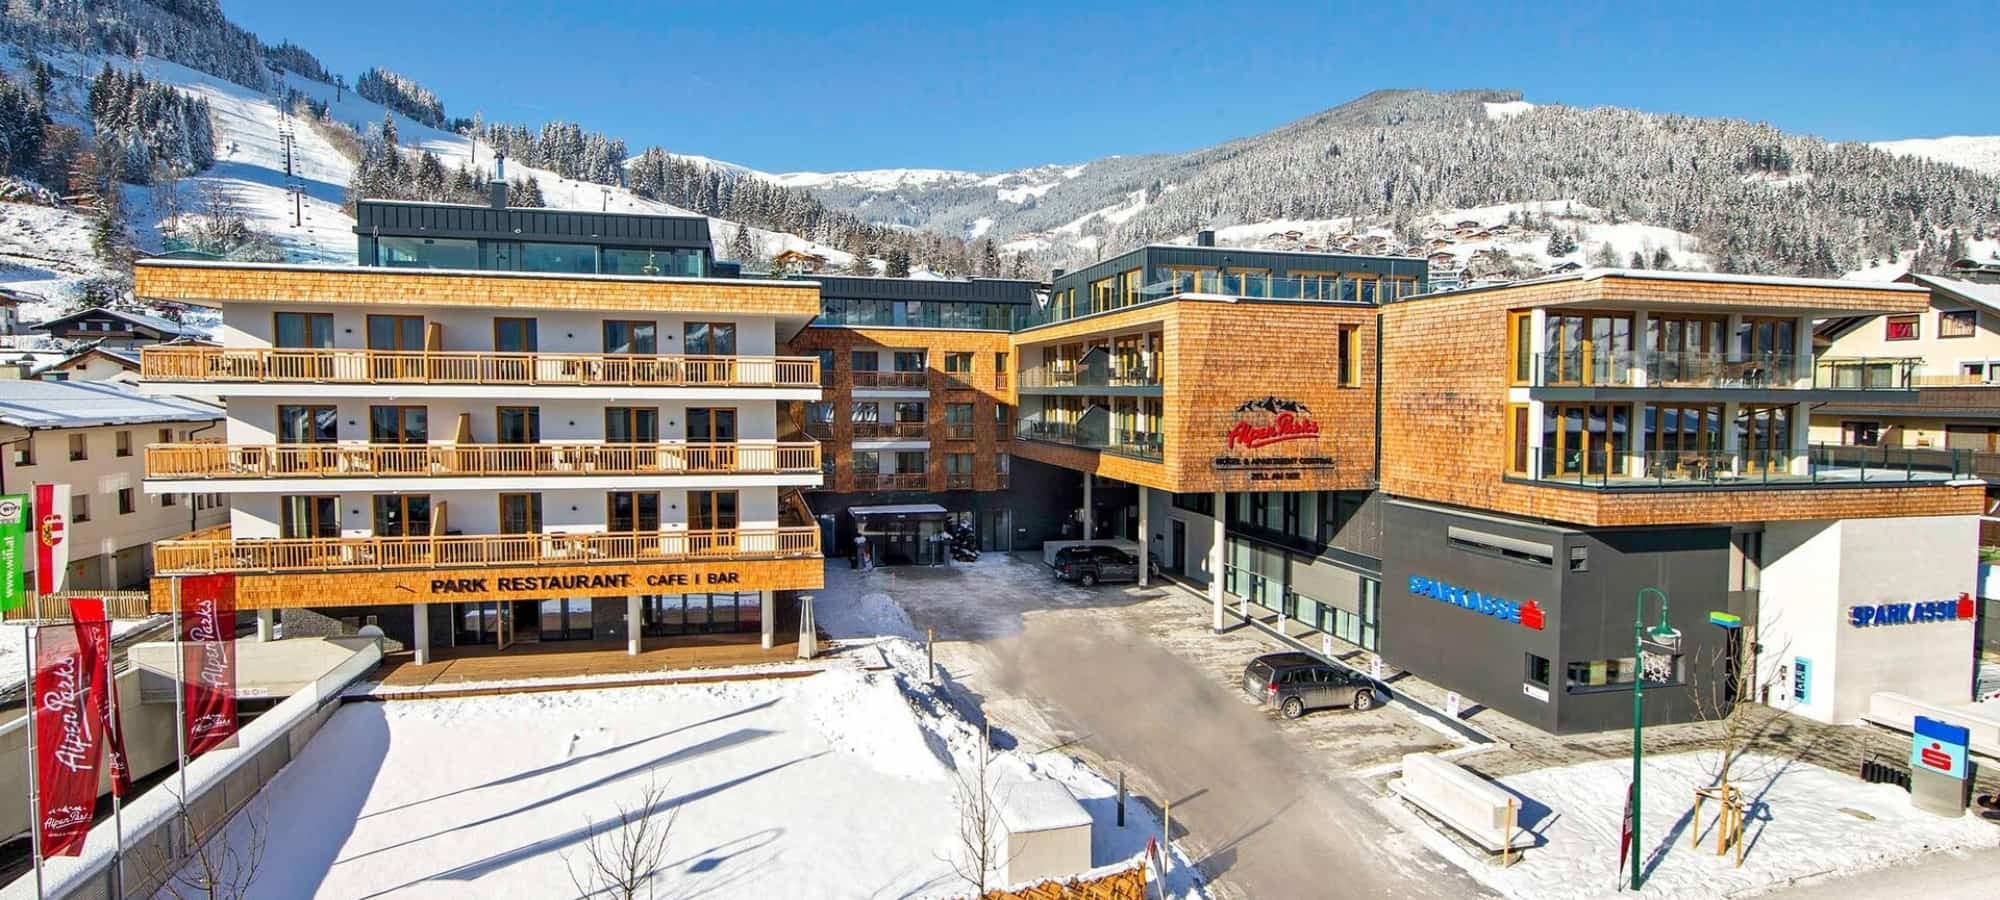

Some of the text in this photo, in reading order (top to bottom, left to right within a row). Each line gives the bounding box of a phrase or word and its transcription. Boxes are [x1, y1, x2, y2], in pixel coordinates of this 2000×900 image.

[431, 573, 631, 594] PARK RESTAURANT
[646, 574, 689, 586] CAFE
[707, 571, 739, 585] BAR
[1407, 575, 1521, 625] SPARKASSE
